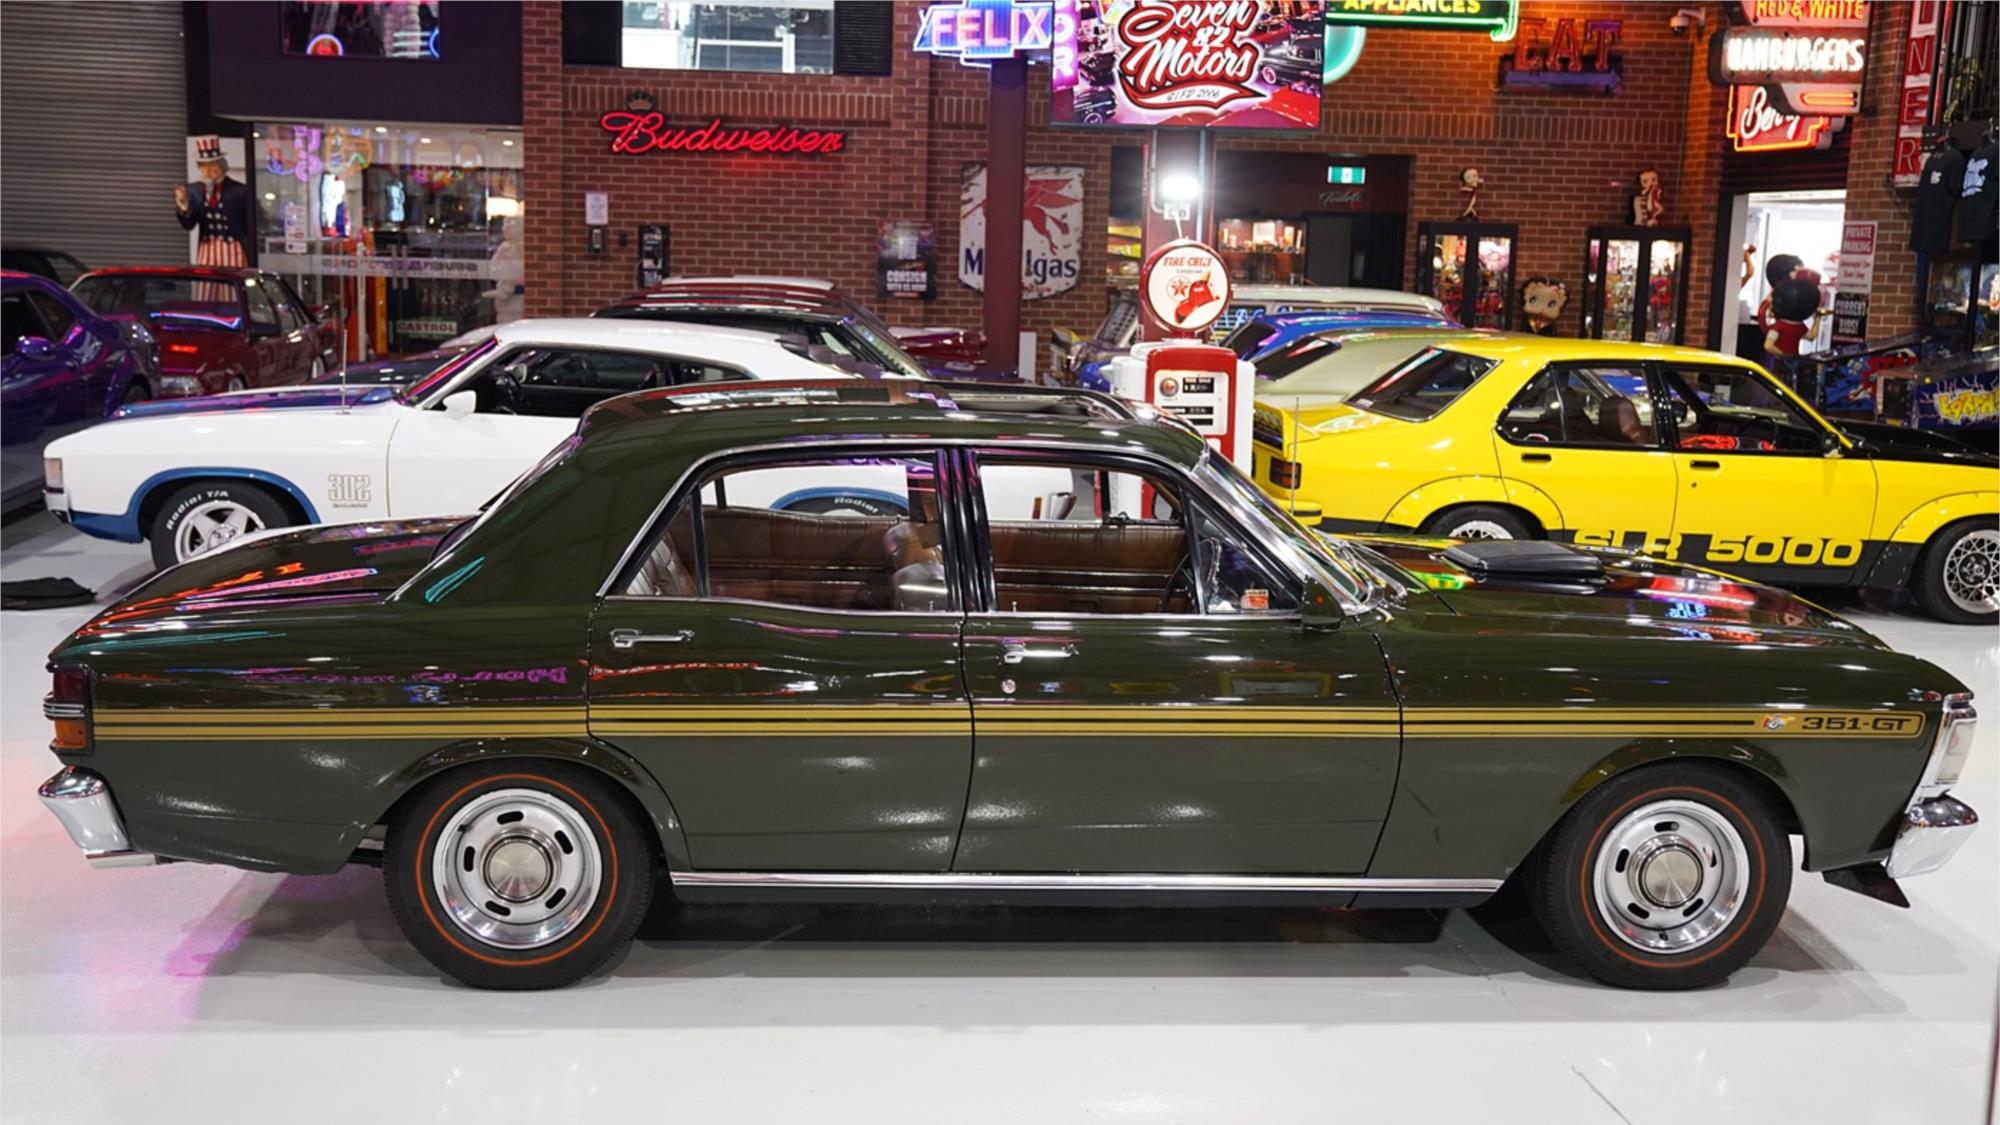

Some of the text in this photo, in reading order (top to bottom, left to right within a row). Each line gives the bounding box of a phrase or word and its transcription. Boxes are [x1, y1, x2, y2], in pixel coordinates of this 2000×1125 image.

[931, 8, 1048, 47] FELIX
[1192, 26, 1231, 47] 82
[1514, 18, 1623, 71] EAT
[1125, 37, 1253, 88] Motors
[1727, 37, 1865, 72] HAMBURGERS
[601, 112, 843, 153] Budweiser
[964, 248, 1077, 285] Mlgas
[328, 474, 372, 502] 302
[833, 496, 879, 514] Radial
[165, 494, 203, 532] Radial
[1705, 533, 1864, 567] 5000
[1801, 715, 1913, 732] 351-GT
